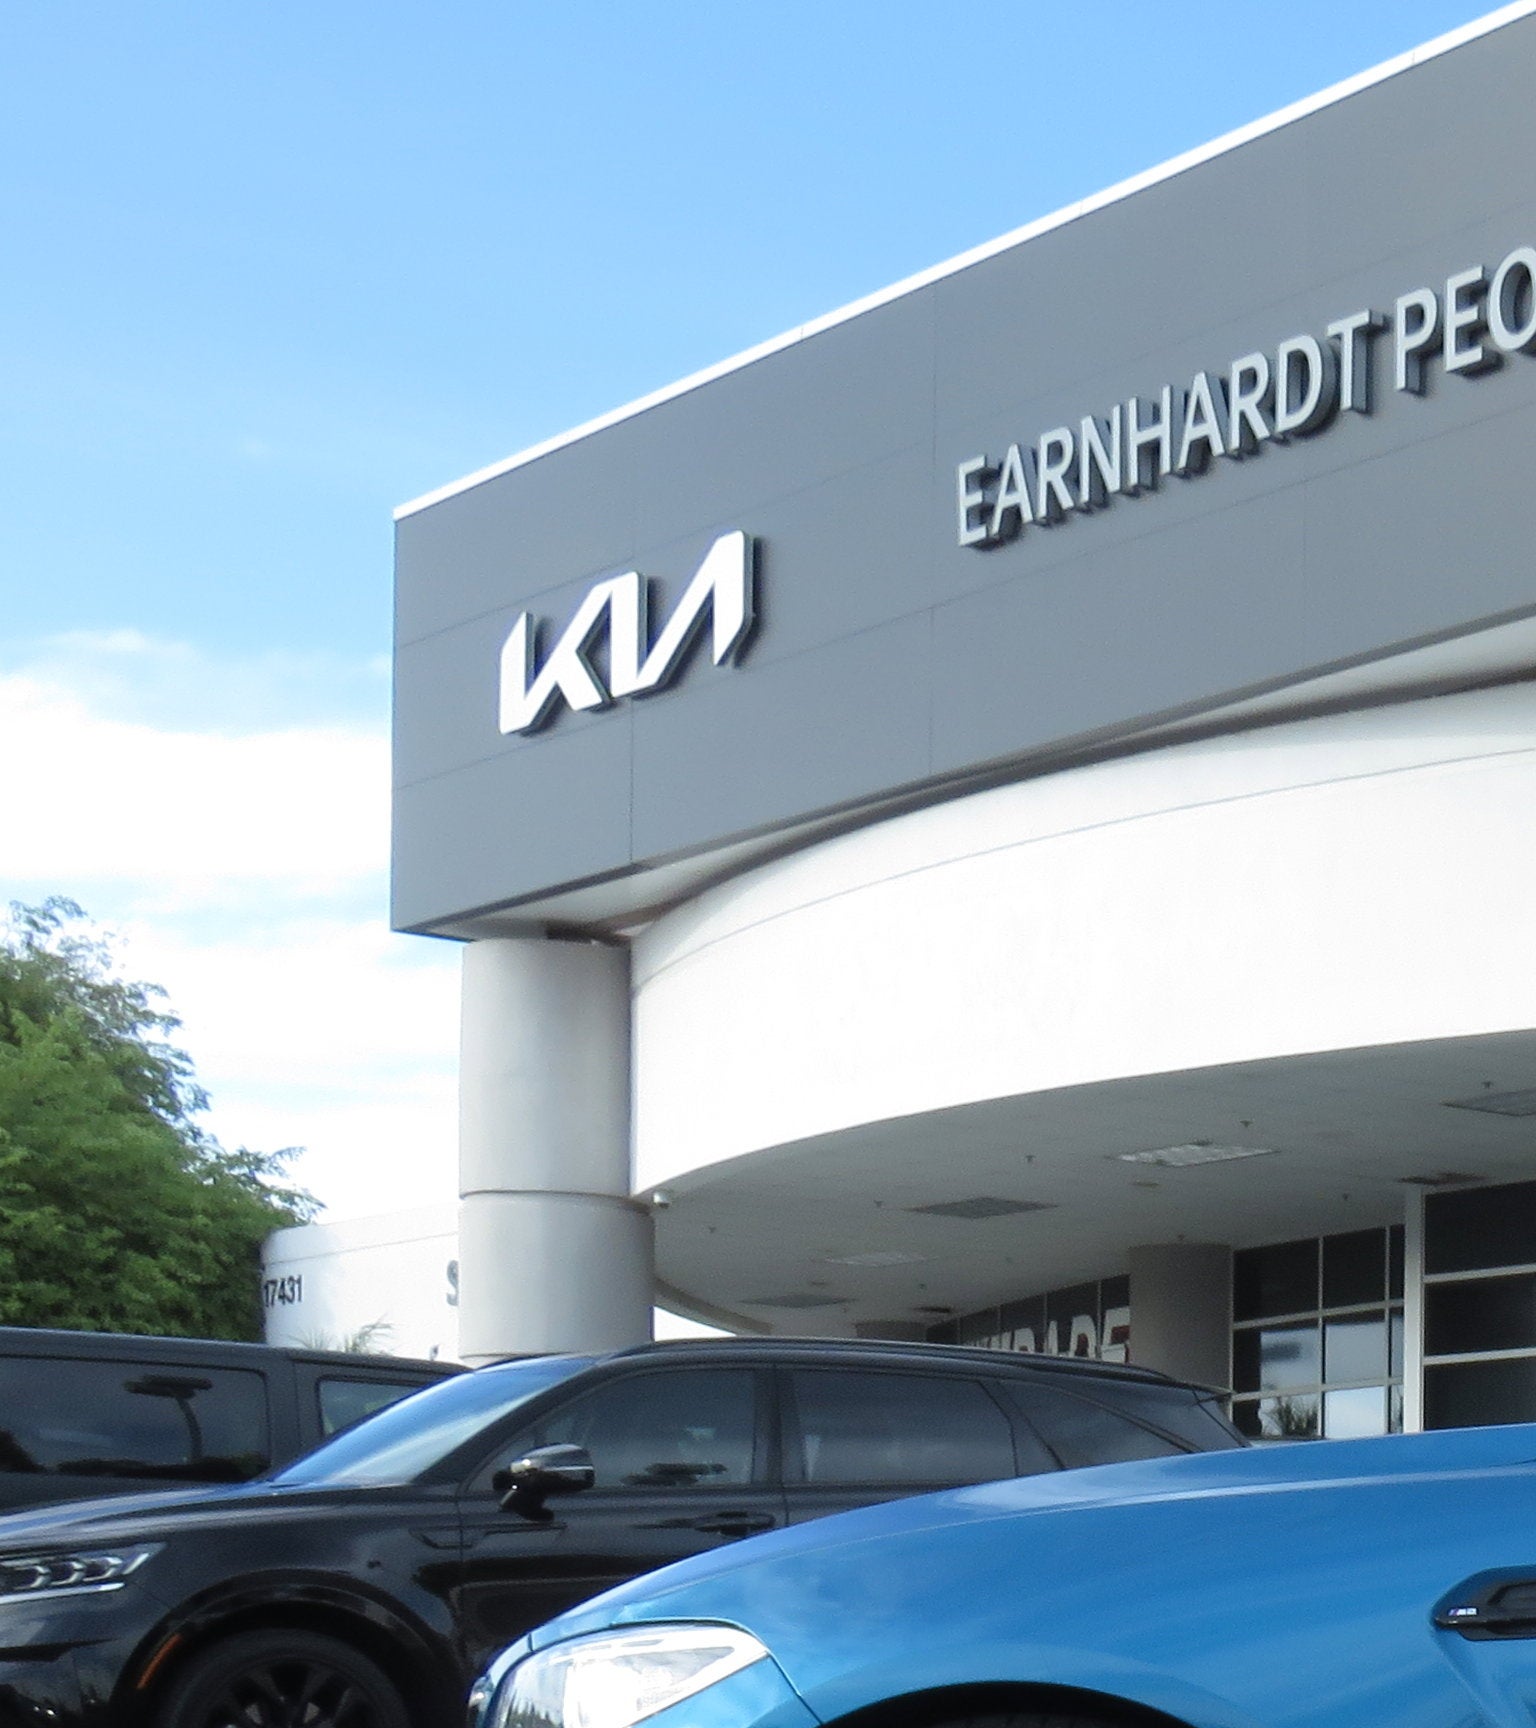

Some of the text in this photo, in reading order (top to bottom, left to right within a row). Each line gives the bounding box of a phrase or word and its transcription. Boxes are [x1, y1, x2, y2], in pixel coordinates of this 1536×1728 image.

[957, 310, 1384, 549] EARNHARDT
[499, 529, 754, 735] KIA
[263, 1274, 303, 1308] 17431
